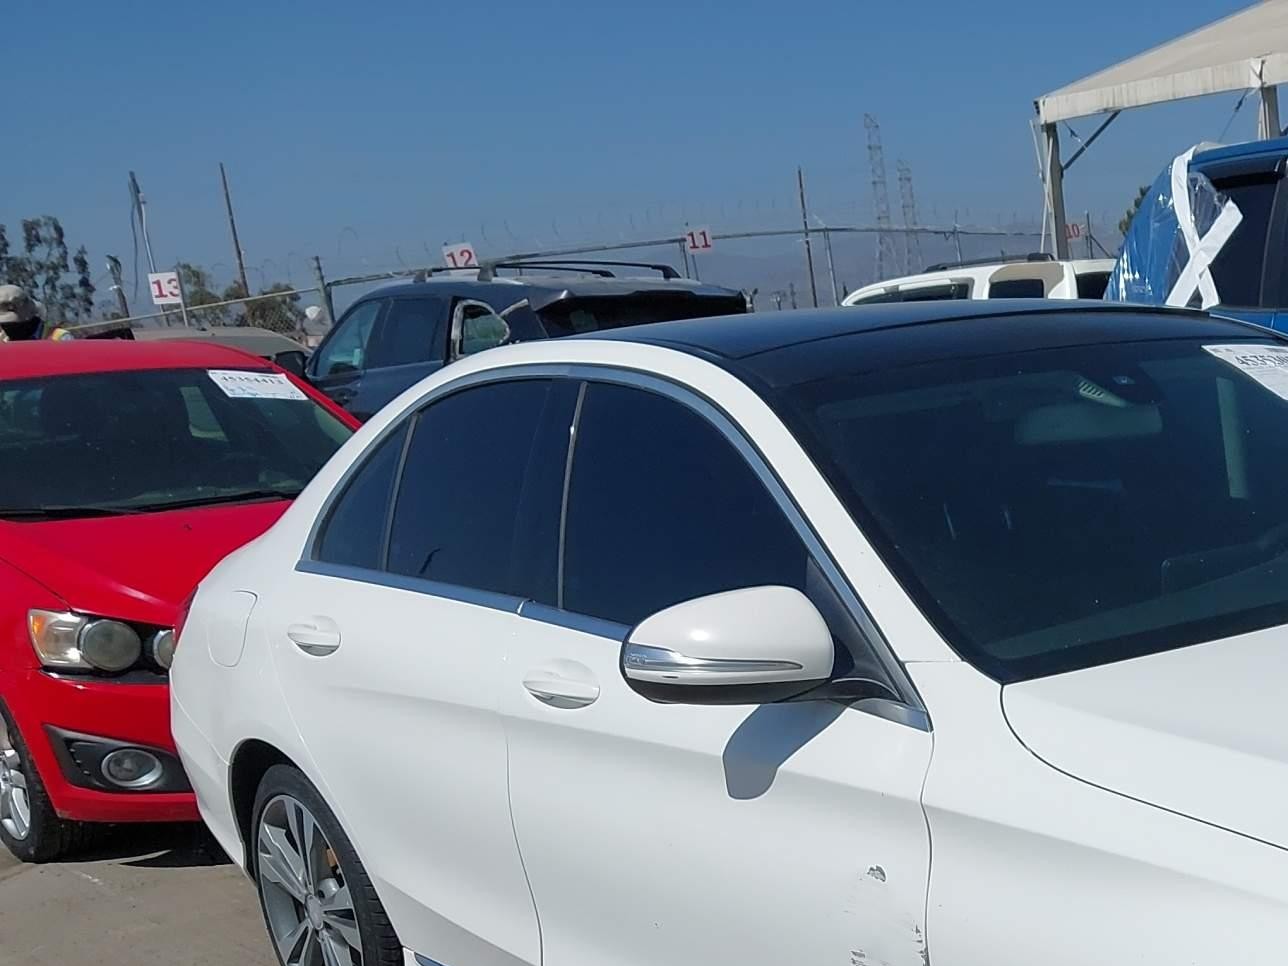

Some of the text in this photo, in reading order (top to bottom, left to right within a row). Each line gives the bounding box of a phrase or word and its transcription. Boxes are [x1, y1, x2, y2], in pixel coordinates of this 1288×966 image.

[687, 231, 711, 248] 11
[446, 249, 477, 268] 12
[152, 278, 180, 298] 13
